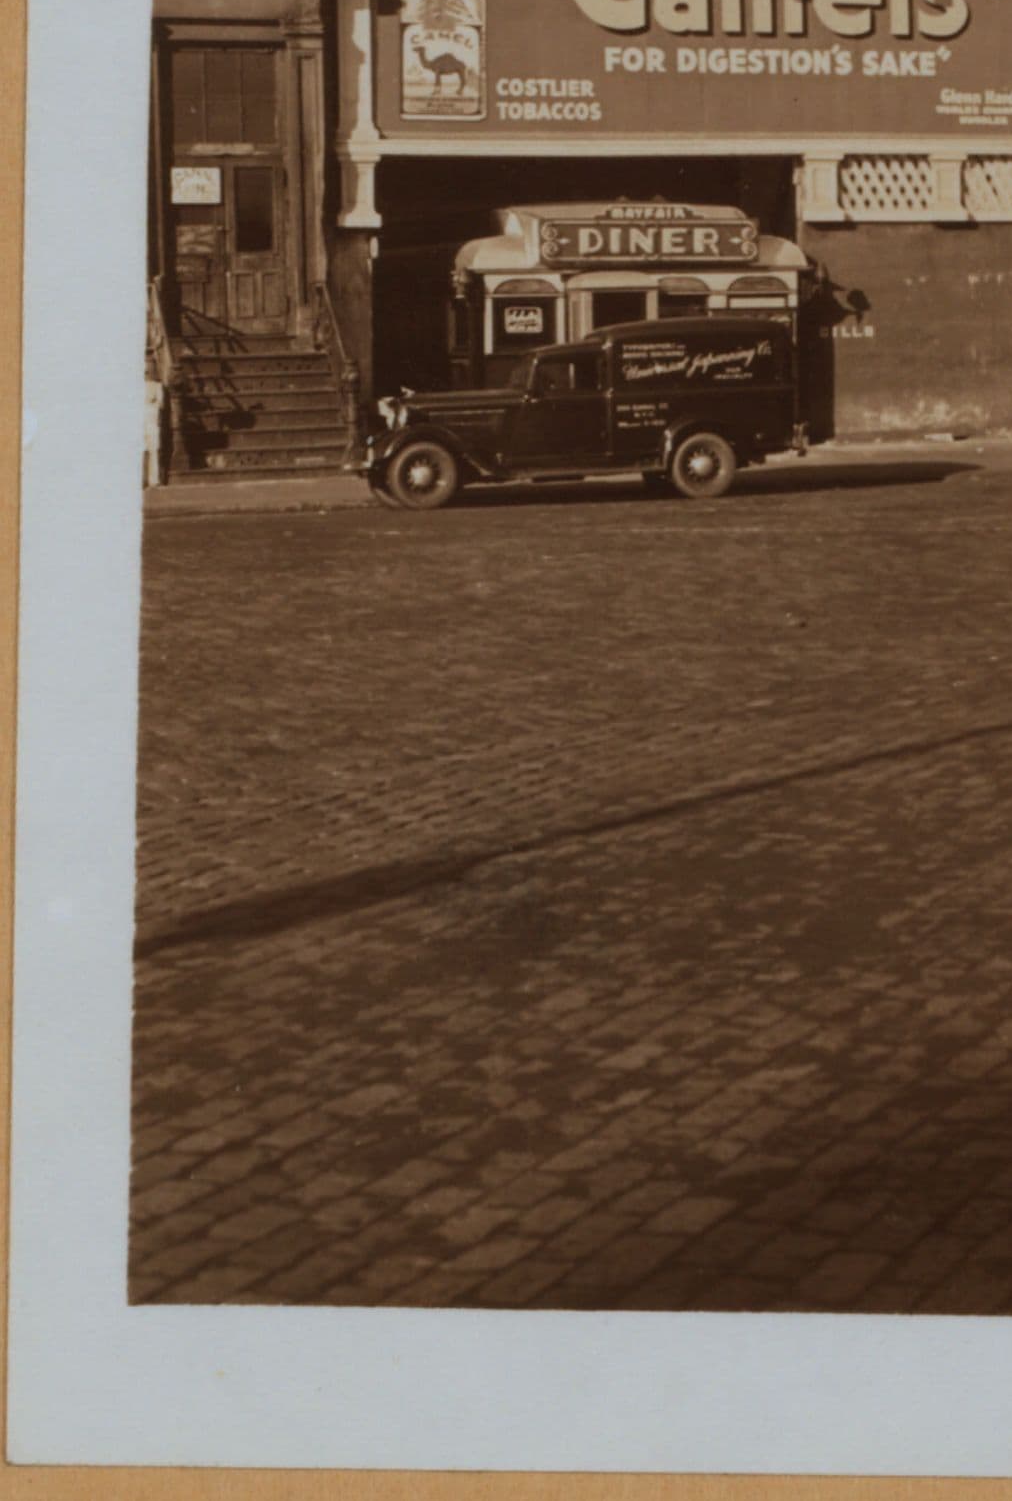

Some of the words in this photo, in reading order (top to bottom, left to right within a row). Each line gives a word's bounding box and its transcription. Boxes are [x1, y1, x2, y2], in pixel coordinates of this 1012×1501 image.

[410, 31, 474, 50] CAMEL
[604, 46, 666, 74] FOR
[677, 44, 853, 76] DIGESTION'S
[496, 77, 595, 98] COSTLIER
[496, 99, 602, 122] TOBACCOS
[578, 226, 722, 256] DINER
